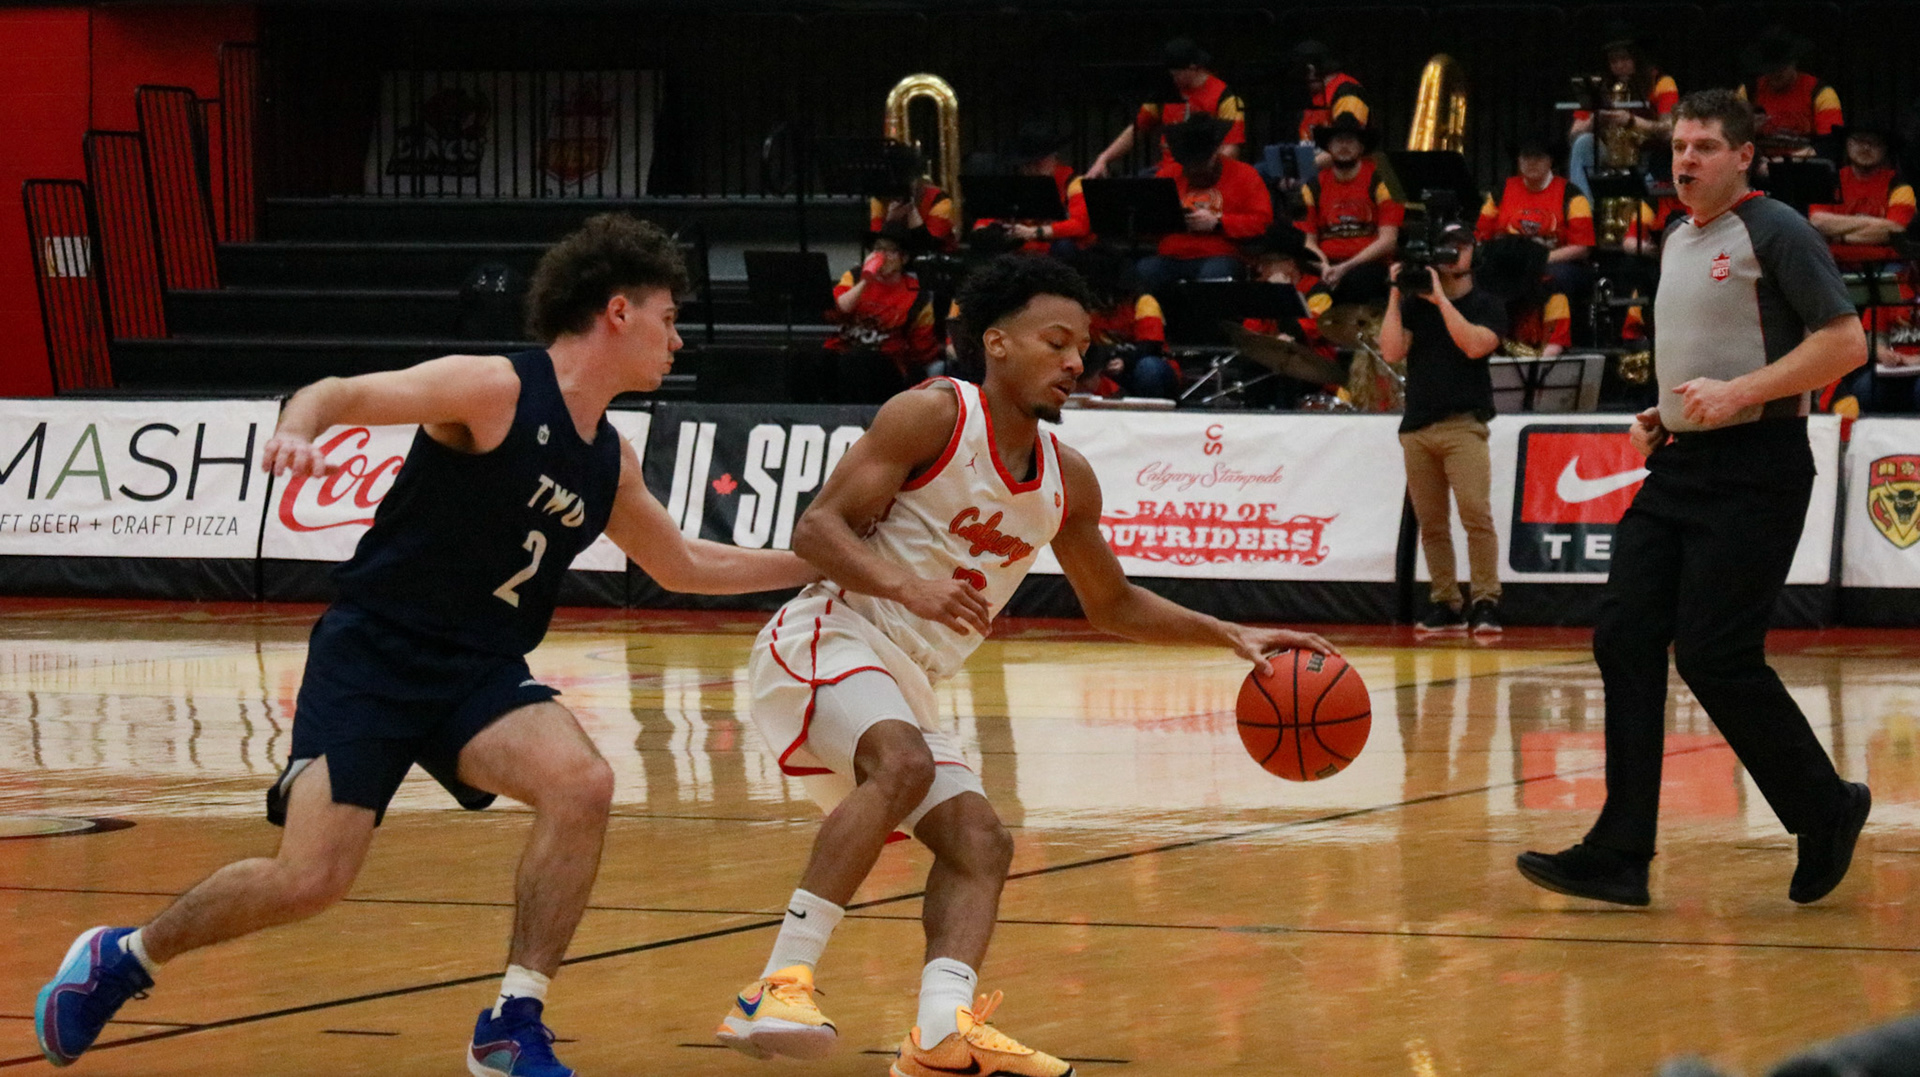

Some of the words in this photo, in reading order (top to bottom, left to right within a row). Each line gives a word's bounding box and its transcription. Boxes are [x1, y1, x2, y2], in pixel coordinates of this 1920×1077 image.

[1136, 461, 1200, 491] Calgary
[1200, 463, 1284, 491] Stampede
[29, 514, 80, 533] BEER
[112, 515, 176, 535] CRAFT
[183, 517, 239, 536] PIZZA
[1137, 500, 1229, 519] BAND
[1238, 502, 1277, 520] OF
[949, 506, 1034, 568] Calgary
[493, 530, 548, 609] 2
